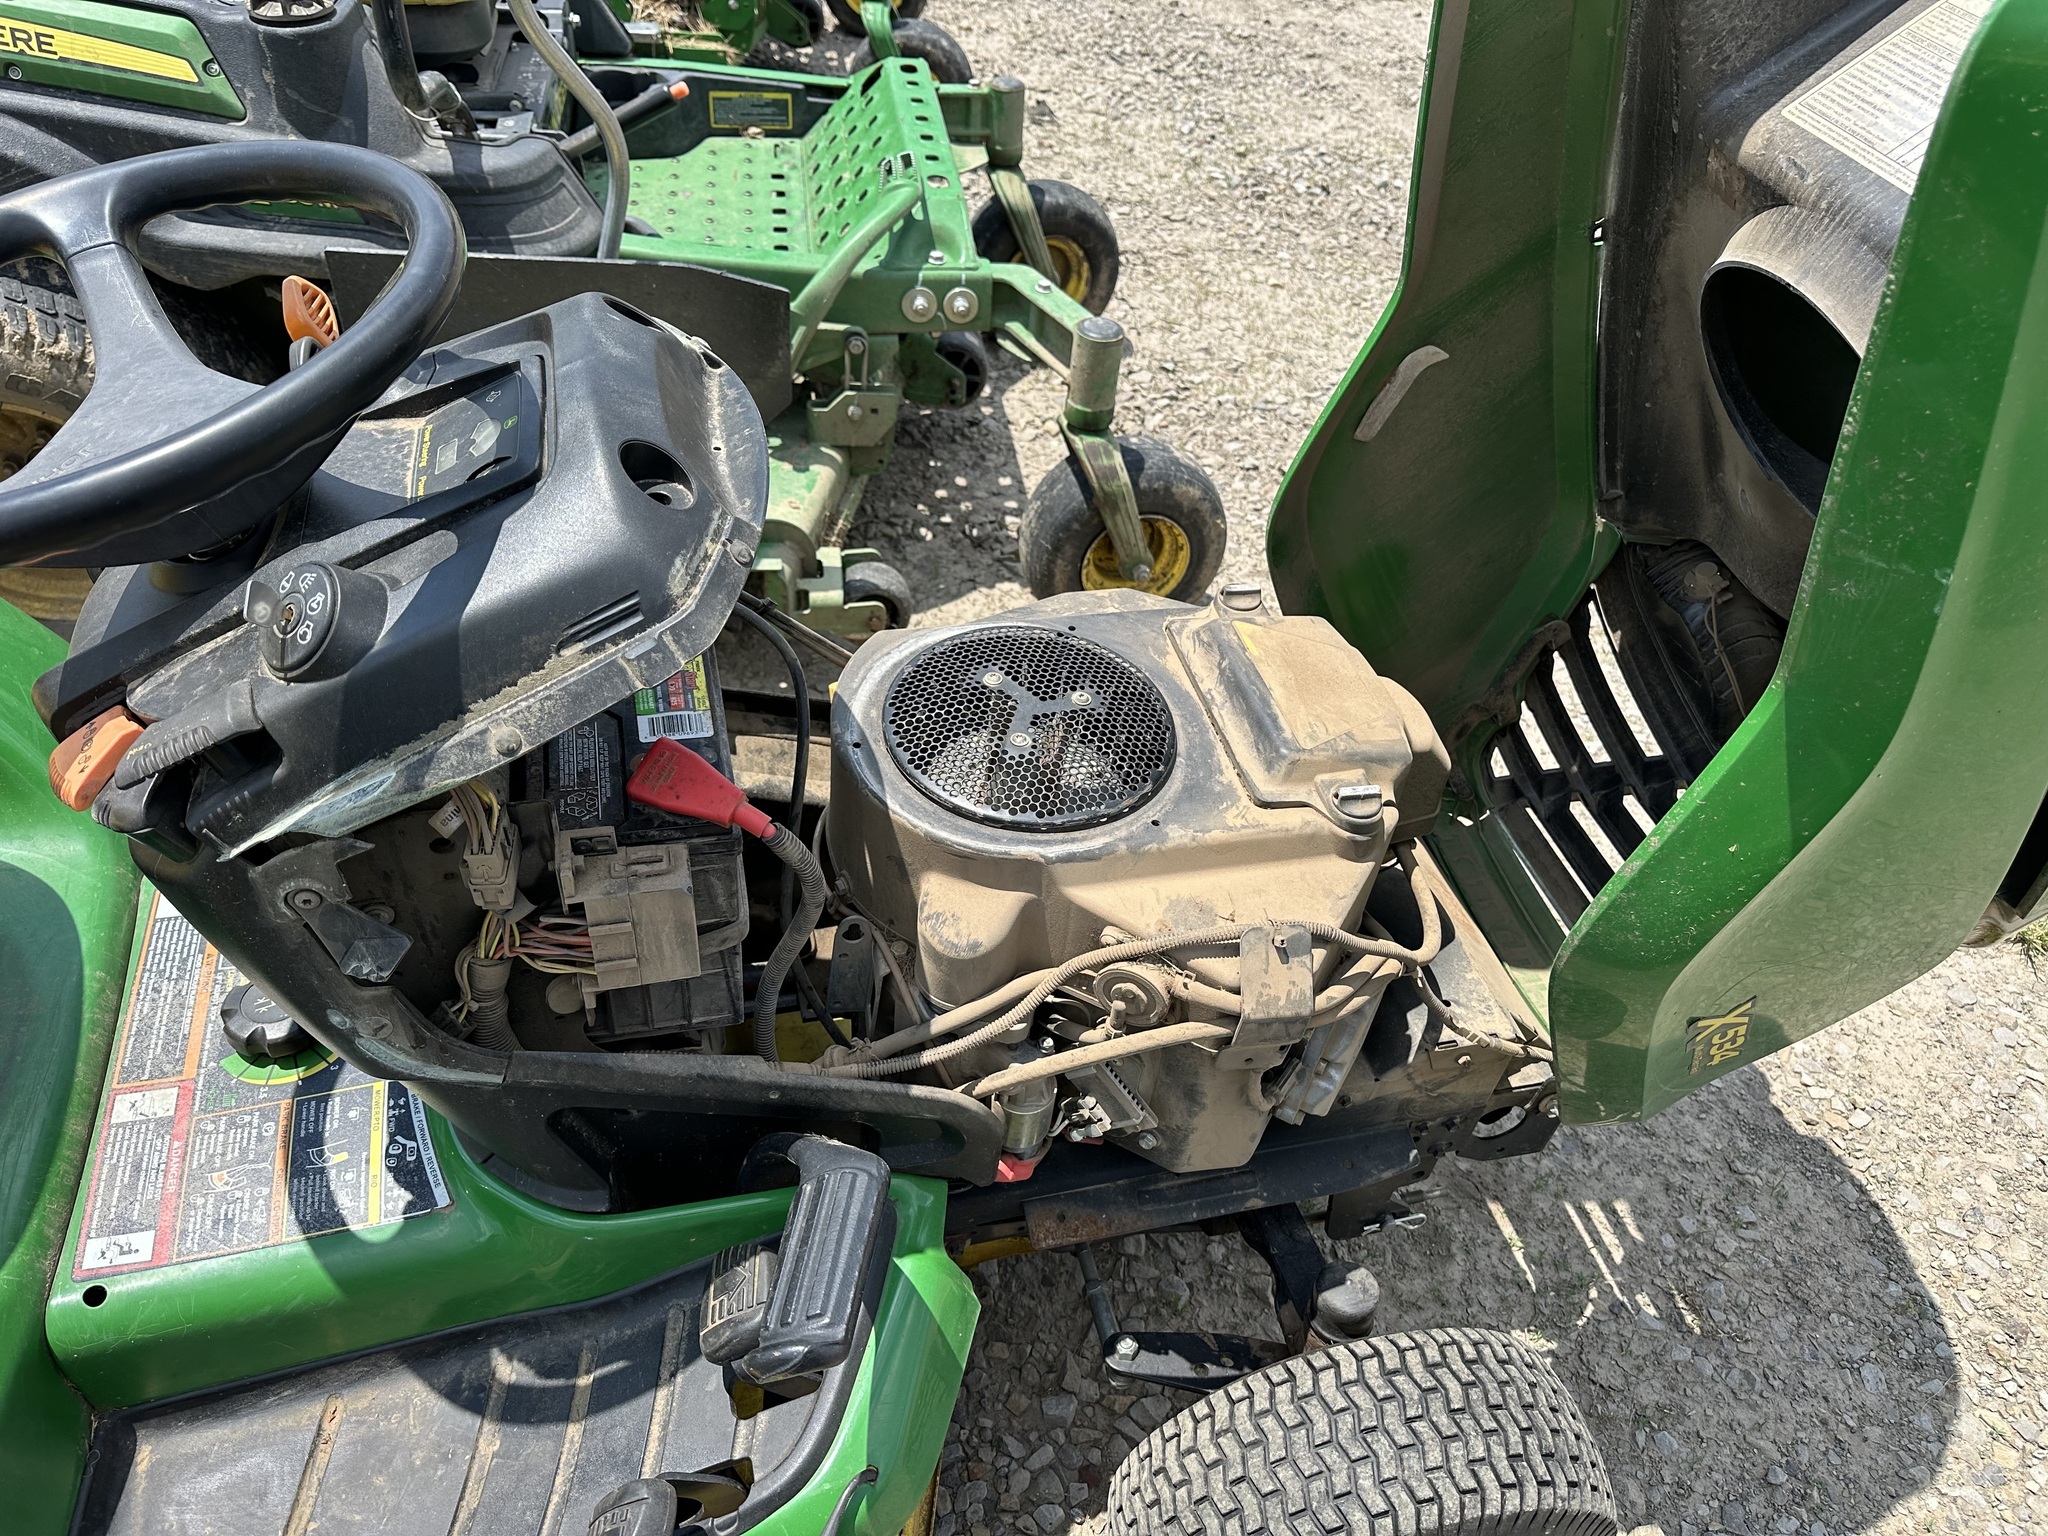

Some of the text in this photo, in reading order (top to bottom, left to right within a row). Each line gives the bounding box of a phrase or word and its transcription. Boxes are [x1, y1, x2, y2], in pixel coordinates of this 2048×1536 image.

[419, 442, 430, 467] Steering
[1696, 1000, 1752, 1066] X534
[259, 1087, 267, 1099] 3.5
[149, 1122, 155, 1130] Do
[252, 1112, 260, 1128] PARK
[333, 1119, 339, 1128] ON
[388, 1118, 396, 1133] FWD
[249, 1129, 258, 1149] BRAKE
[370, 1090, 381, 1188] MOWER/PTO RIO
[411, 1094, 421, 1115] BRAKE
[417, 1120, 430, 1152] FORWARD
[426, 1157, 441, 1188] REVERSE
[160, 1135, 170, 1163] ROTATING
[151, 1151, 159, 1168] ARMS
[149, 1170, 157, 1182] AND
[157, 1163, 167, 1188] BLADES
[166, 1149, 181, 1194] DANGER
[271, 1102, 290, 1240] PARK BRAKE CRUISE CONTROL
[146, 1183, 154, 1200] LEGS
[329, 1181, 336, 1190] ON
